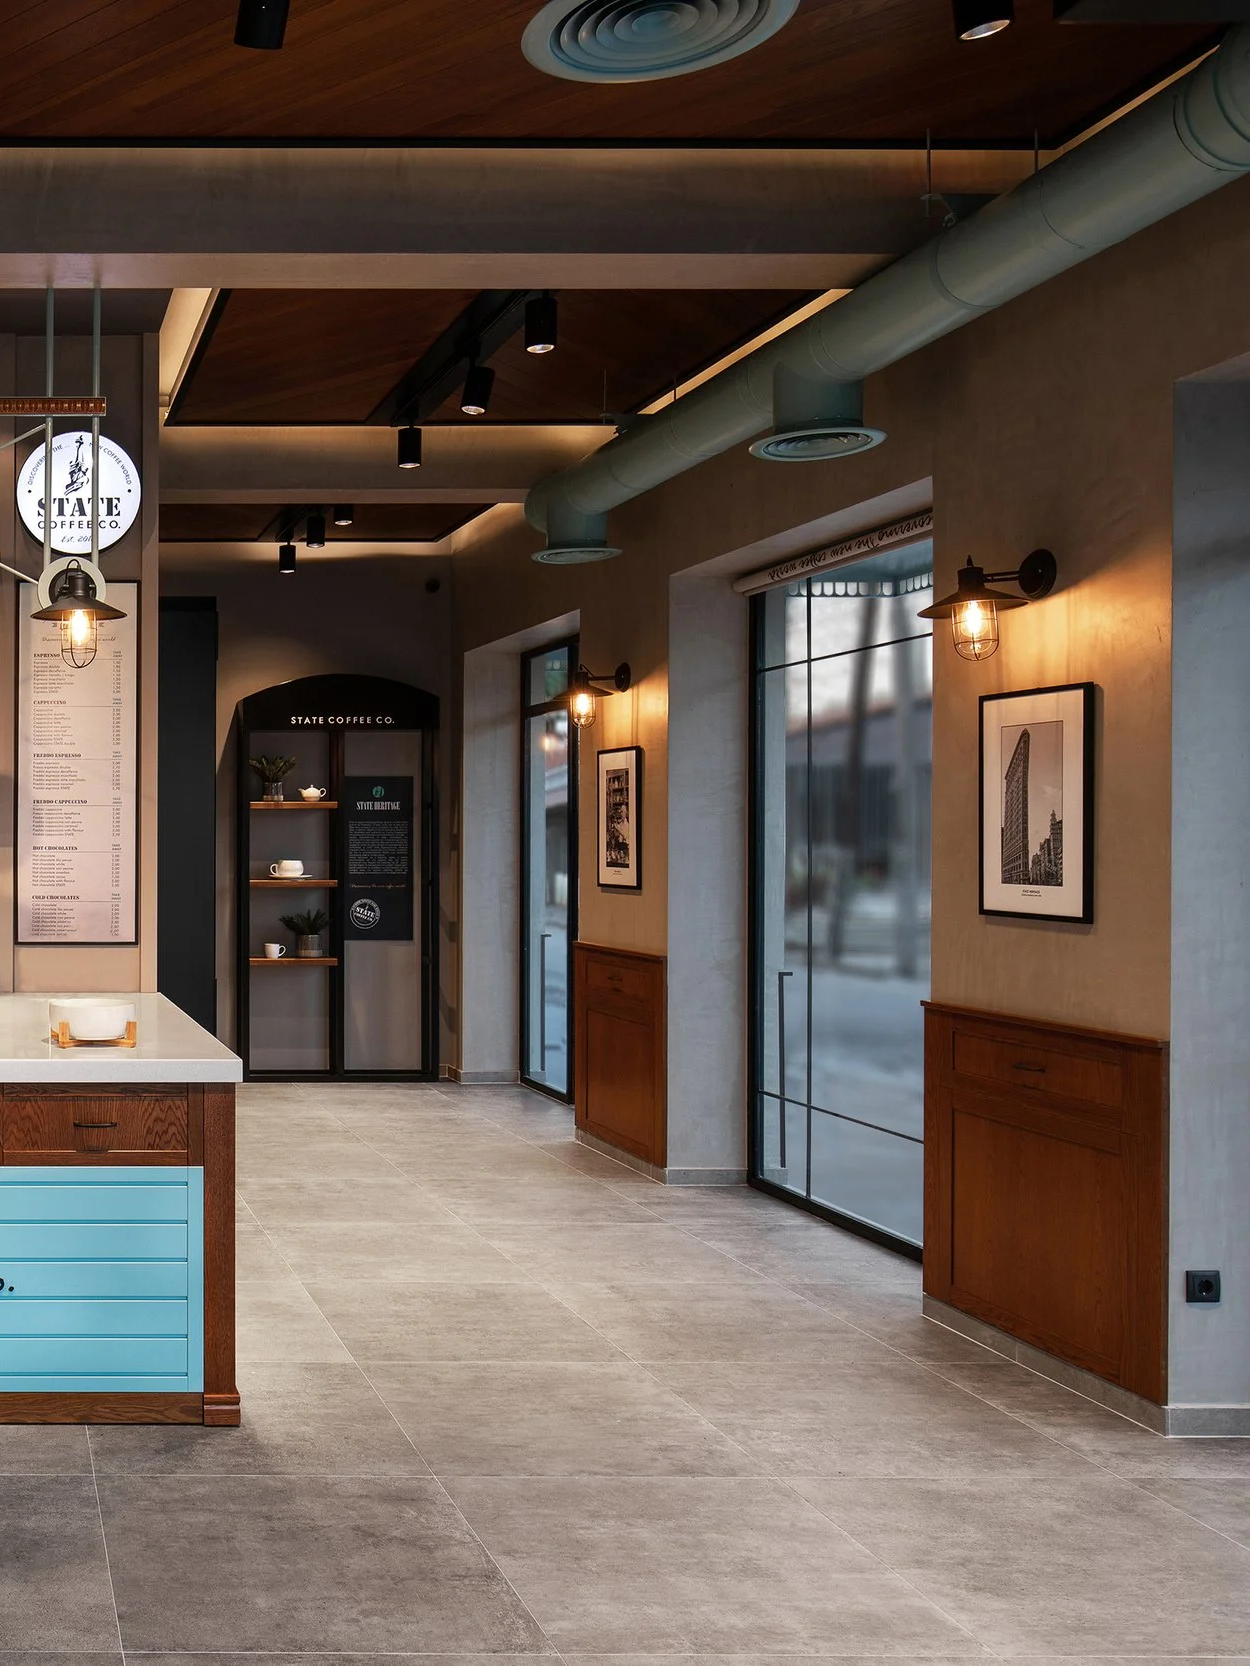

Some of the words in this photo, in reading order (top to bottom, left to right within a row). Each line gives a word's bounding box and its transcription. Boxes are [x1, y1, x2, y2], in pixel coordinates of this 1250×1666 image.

[98, 520, 121, 529] CO.
[290, 716, 324, 724] STATE
[327, 716, 372, 724] COFFEE
[375, 716, 395, 724] CO.
[356, 801, 374, 811] STATE
[374, 801, 401, 811] HERITAGE
